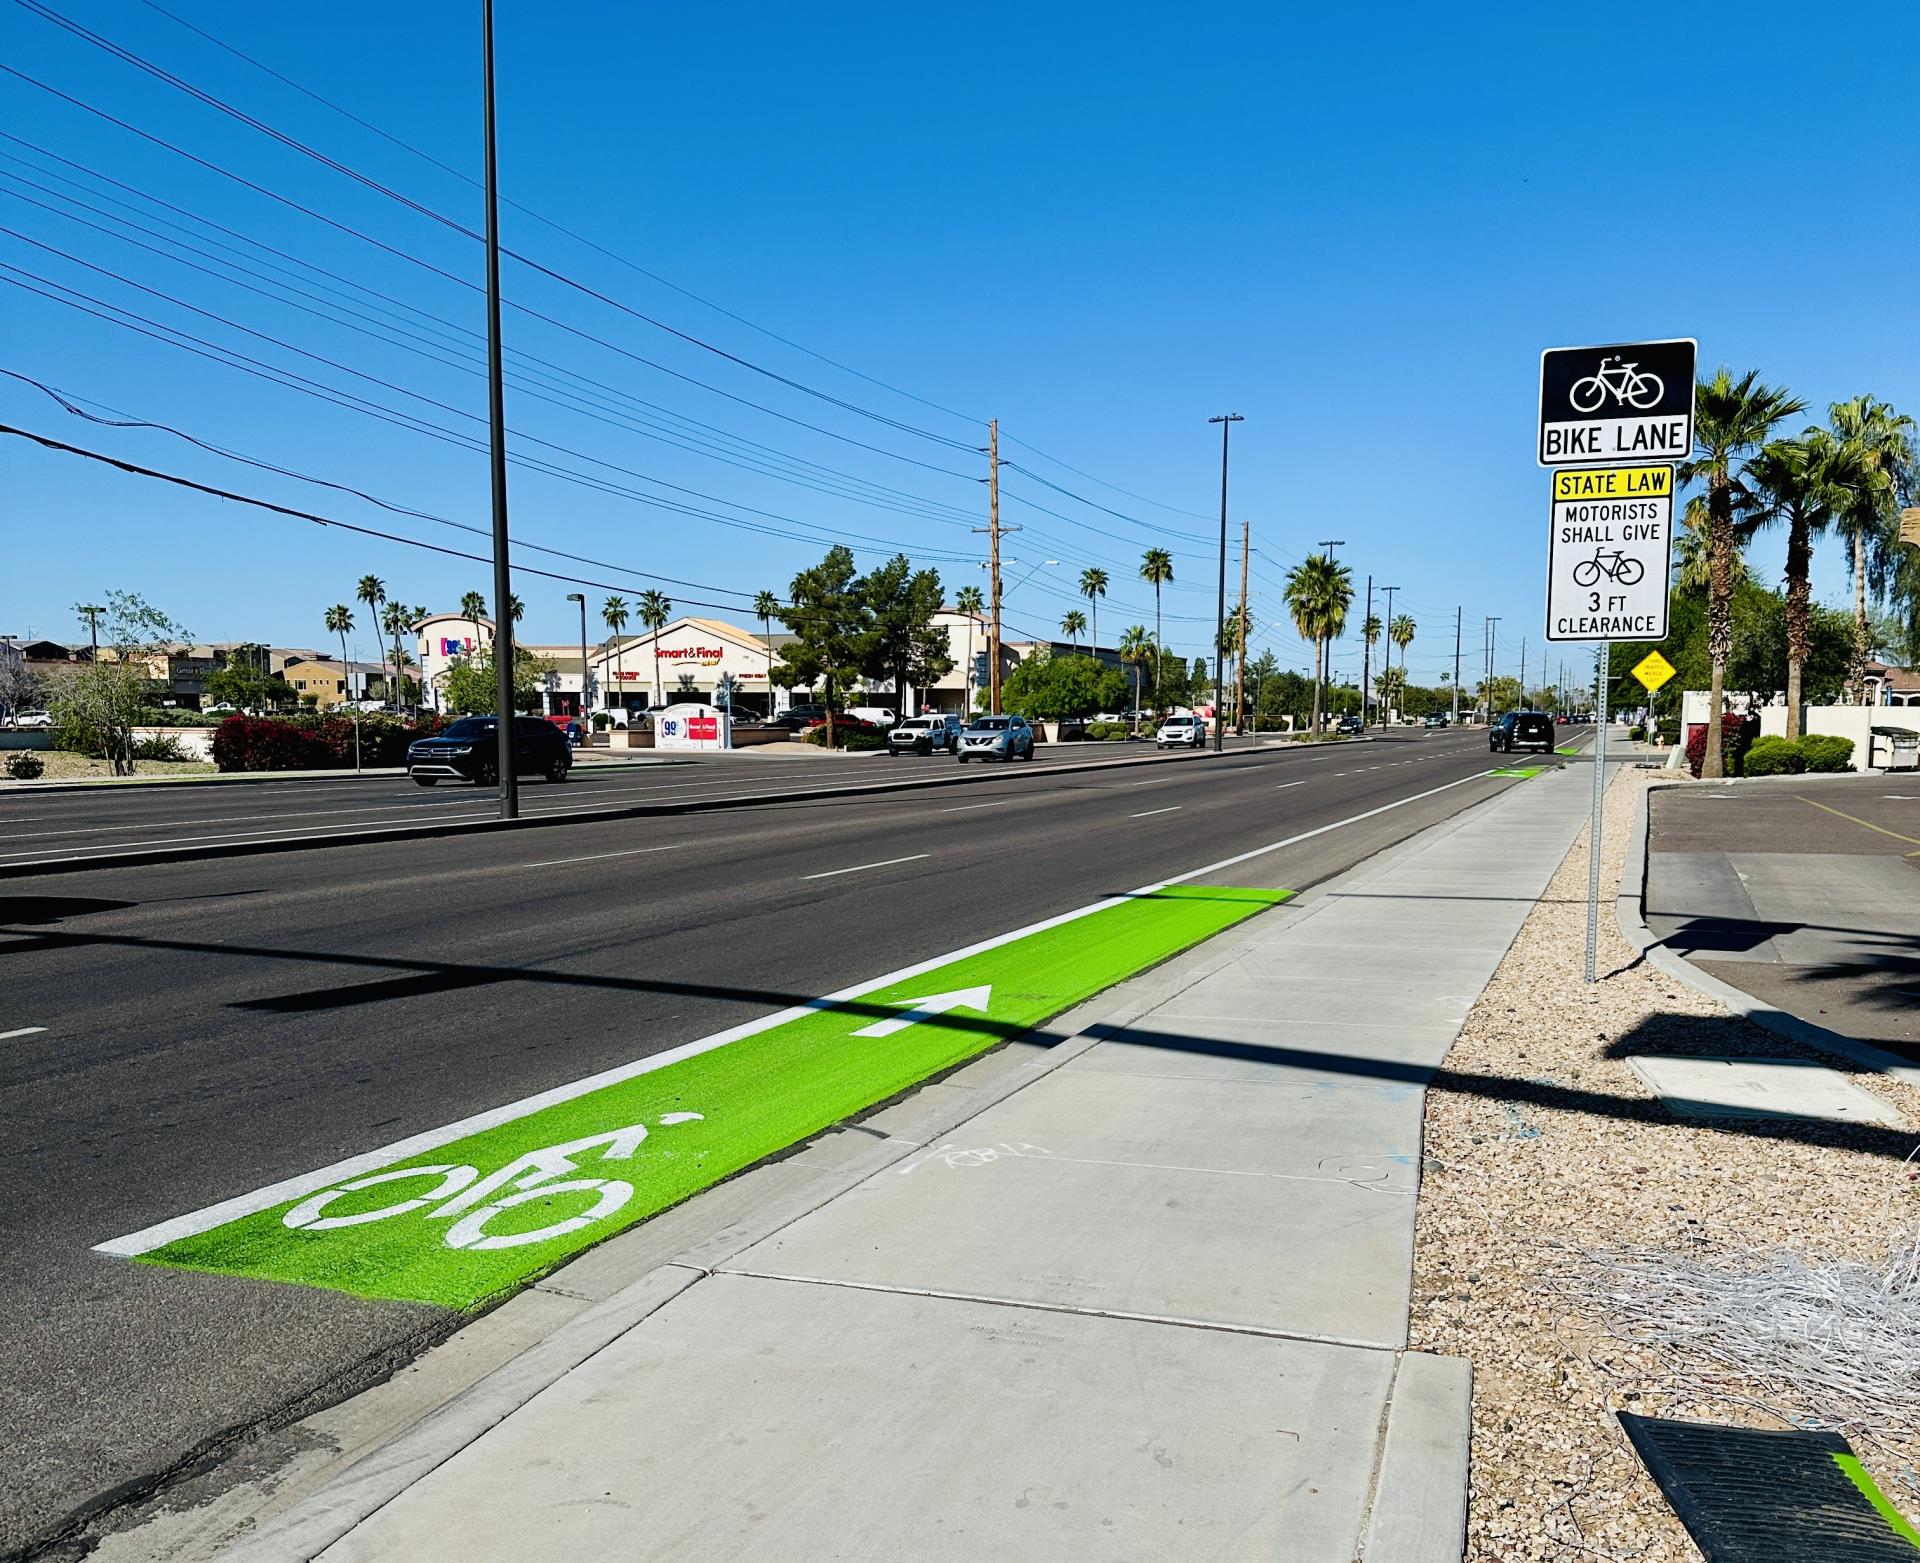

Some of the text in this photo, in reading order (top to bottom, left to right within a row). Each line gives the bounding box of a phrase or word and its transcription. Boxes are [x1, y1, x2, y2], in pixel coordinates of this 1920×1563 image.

[1546, 422, 1684, 455] BIKE LANE
[1560, 472, 1666, 495] STATE LAW
[1565, 503, 1658, 522] MOTORISTS
[1561, 524, 1661, 543] SHALL GIVE
[1588, 592, 1627, 612] 3 FT
[1557, 616, 1656, 633] CLEARANCE
